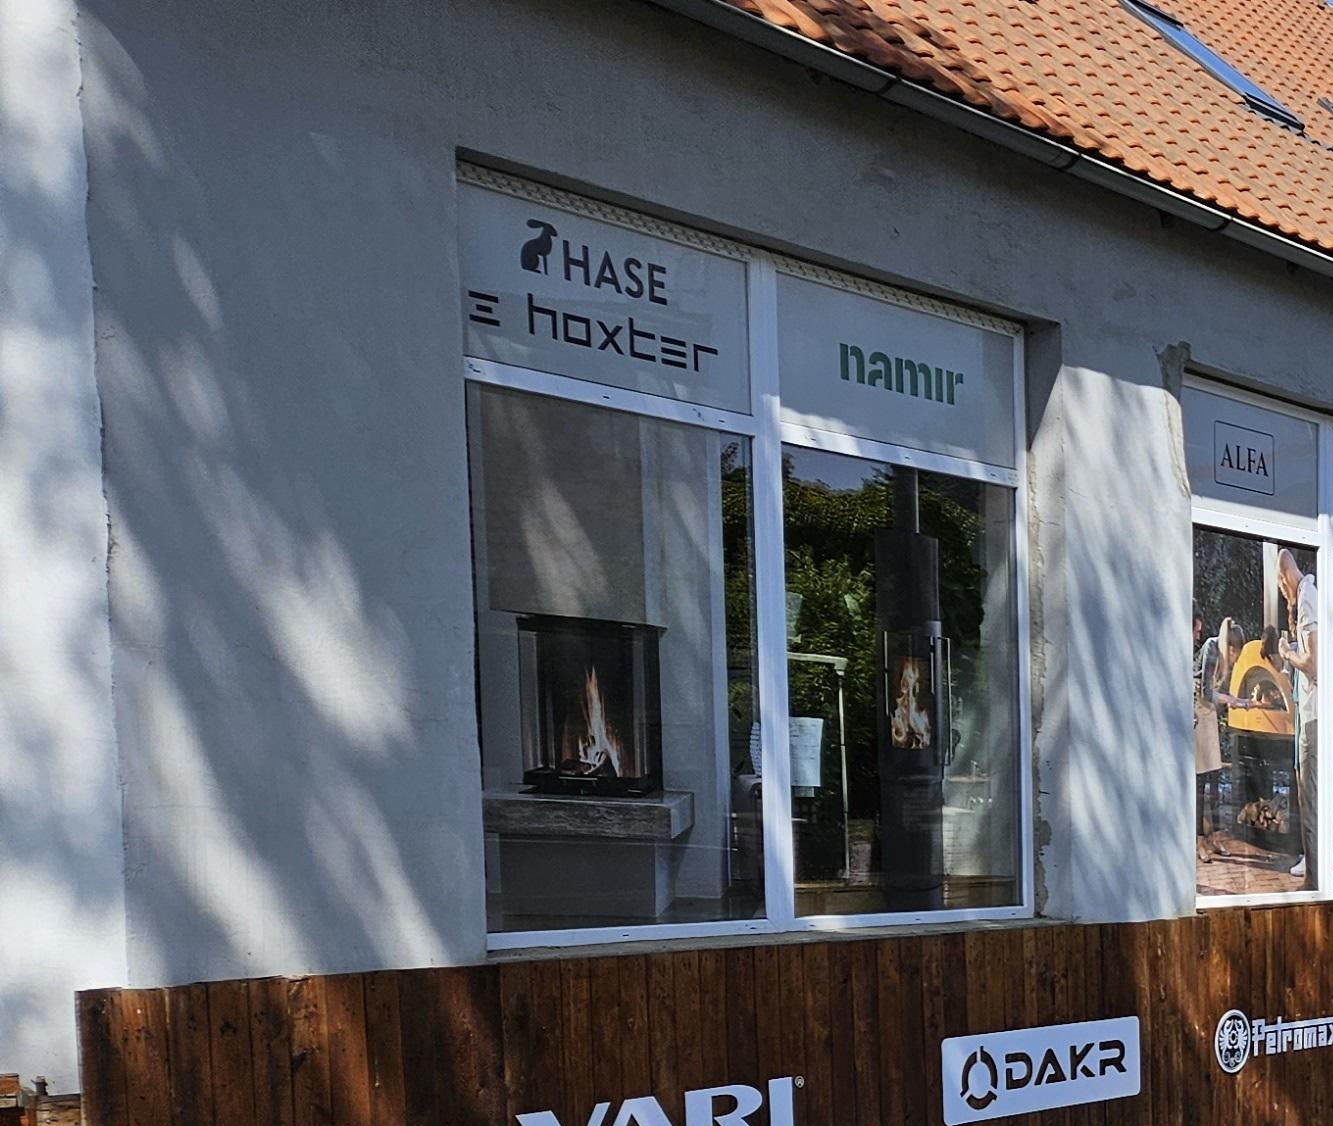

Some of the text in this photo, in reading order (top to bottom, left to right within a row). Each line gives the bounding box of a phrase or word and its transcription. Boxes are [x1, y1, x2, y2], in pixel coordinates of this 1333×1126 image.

[562, 239, 668, 306] HASE
[527, 292, 719, 373] hoxter
[839, 341, 964, 406] namir
[1220, 442, 1269, 477] ALFA
[1004, 1039, 1128, 1091] DAKR
